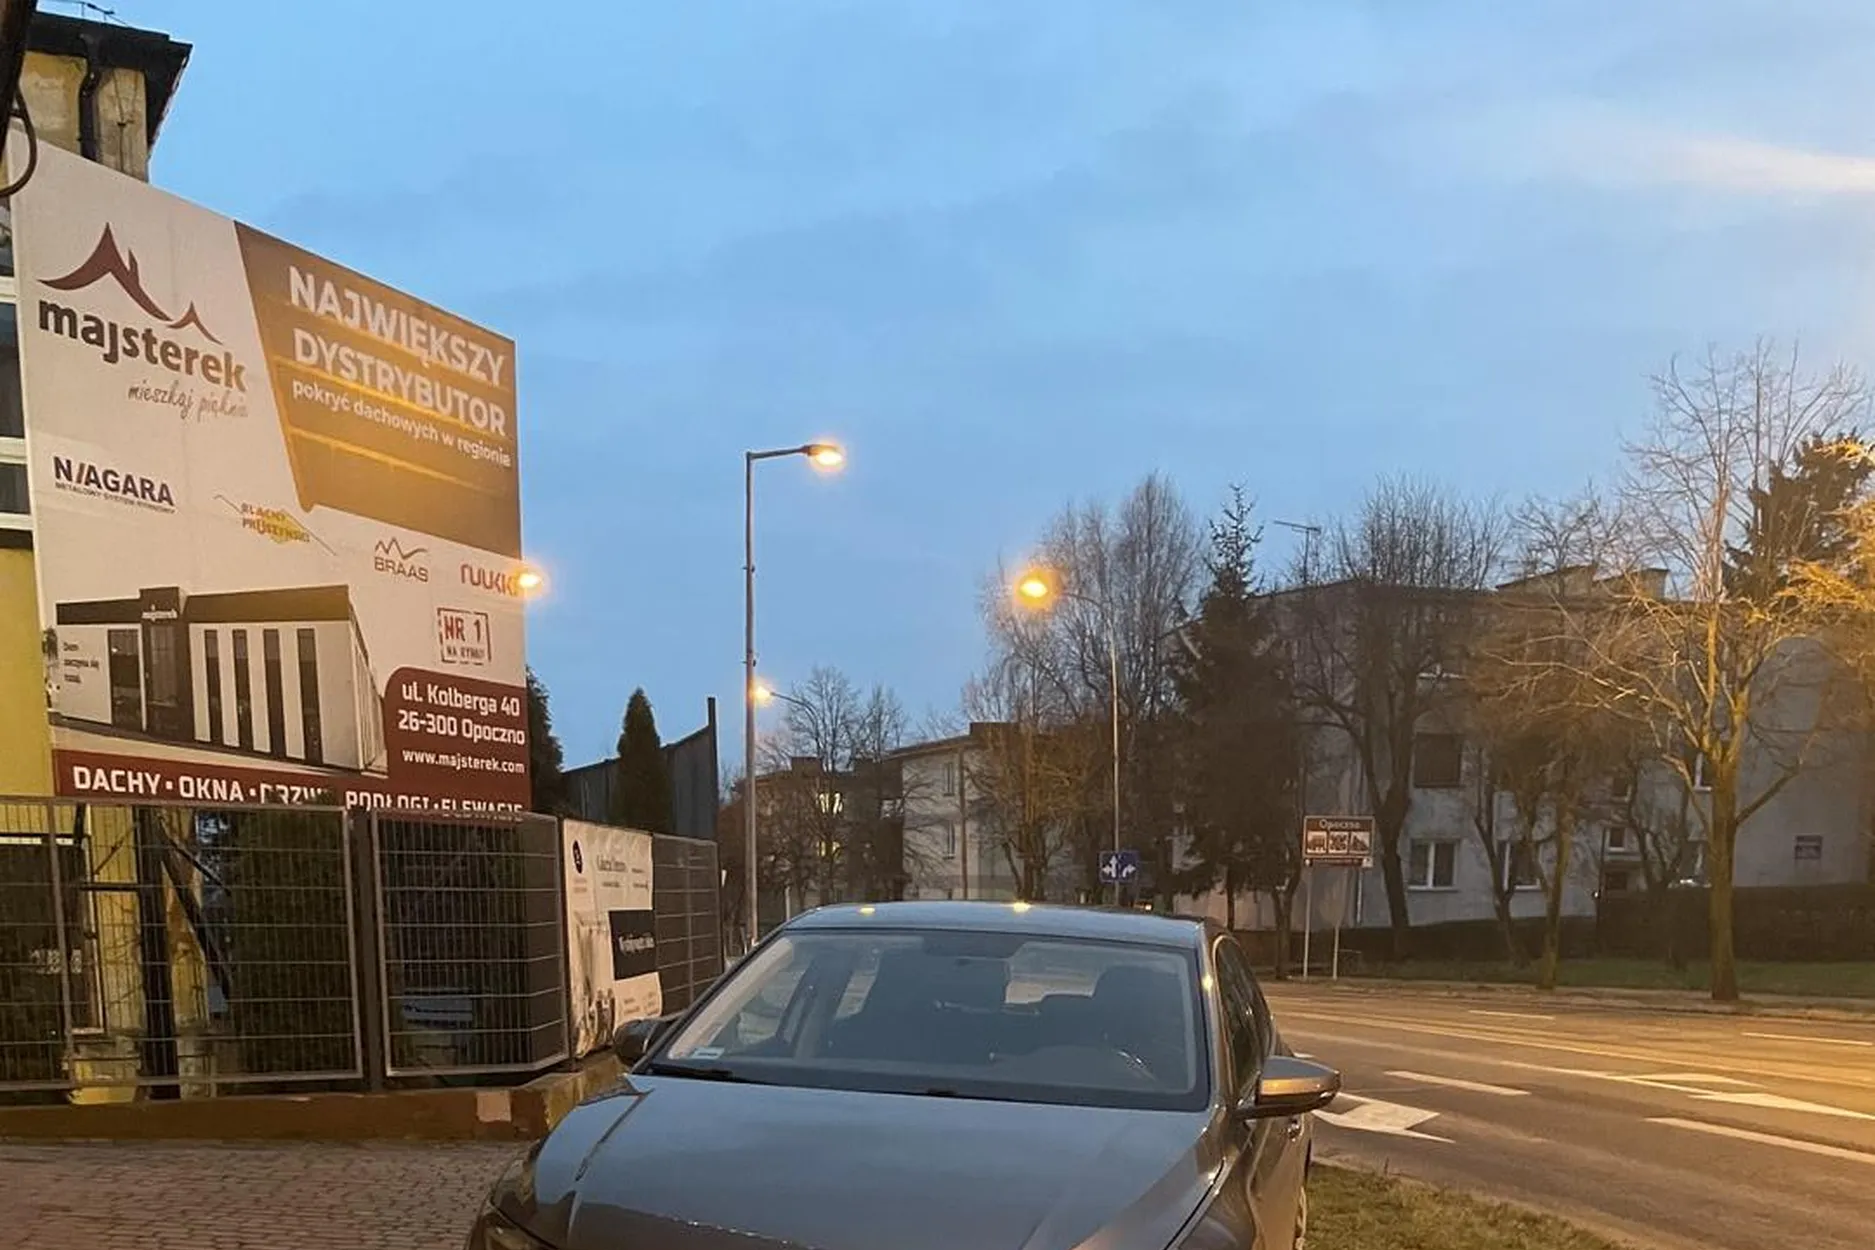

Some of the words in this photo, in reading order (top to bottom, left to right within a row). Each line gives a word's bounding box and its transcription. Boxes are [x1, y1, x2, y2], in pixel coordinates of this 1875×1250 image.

[290, 266, 503, 387] NAJWIĘKSZY
[39, 300, 246, 392] majsterek
[294, 328, 505, 436] DYSTRYBUTOR
[292, 379, 351, 413] pokryć
[353, 399, 438, 443] dachowych
[440, 430, 453, 446] w
[457, 441, 511, 466] regionie
[53, 456, 175, 507] NIAGARA
[374, 556, 429, 583] BRAAS
[444, 615, 466, 641] NR
[473, 619, 481, 643] 1
[402, 681, 423, 702] ul.
[427, 683, 497, 716] Kolberga
[500, 696, 520, 716] 40
[398, 709, 458, 737] 26-300
[461, 718, 526, 745] Opoczno
[402, 750, 525, 773] www.majsterek.com
[73, 766, 161, 795] DACHY
[179, 775, 244, 801] OKNA
